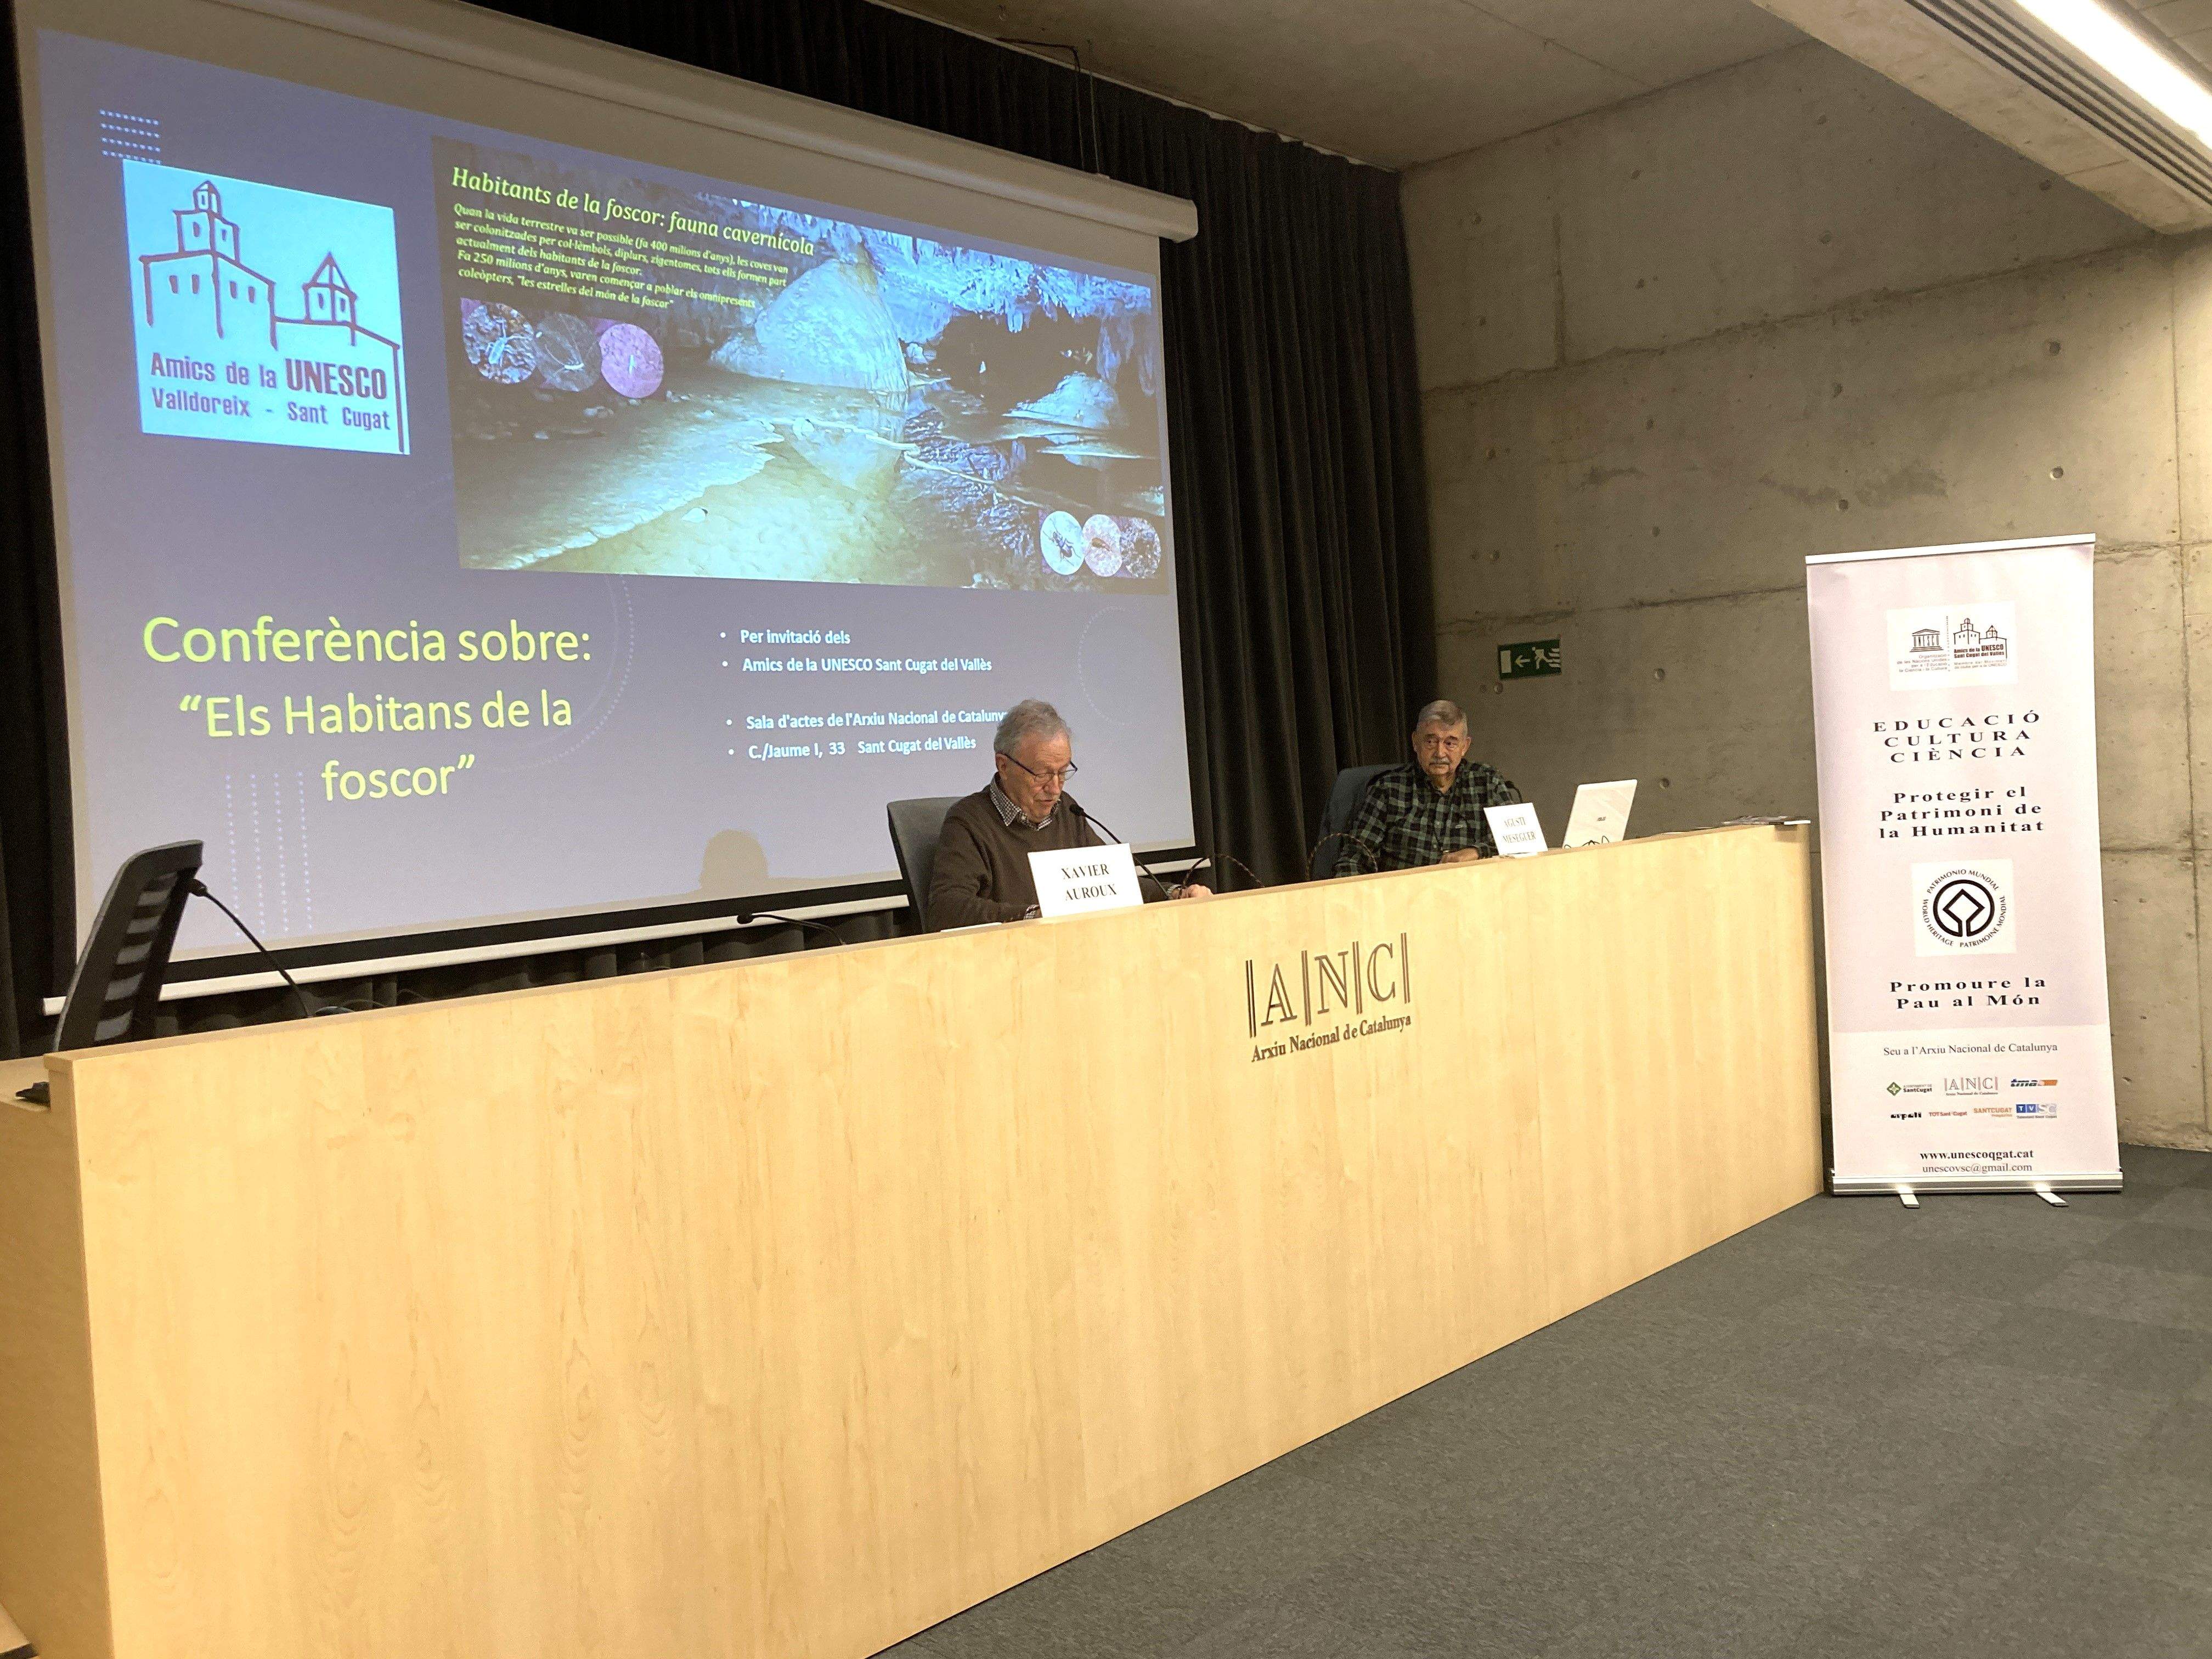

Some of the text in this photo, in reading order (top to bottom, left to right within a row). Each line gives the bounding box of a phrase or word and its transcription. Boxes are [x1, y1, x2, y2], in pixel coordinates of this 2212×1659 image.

[452, 167, 814, 256] Habitants de la foscor: fauna cavernícola
[454, 203, 482, 218] Quan
[485, 209, 494, 219] la
[497, 213, 518, 224] vida
[522, 217, 565, 233] terrestre
[567, 227, 578, 235] va
[580, 229, 594, 238] ser
[597, 232, 633, 245] possible
[635, 236, 648, 250] (fa
[650, 240, 668, 252] 400
[670, 245, 701, 258] milions
[737, 256, 748, 266] les
[750, 261, 772, 272] coves
[774, 264, 788, 274] van
[455, 221, 472, 230] ser
[473, 224, 537, 242] colonitzades
[539, 236, 556, 246] per
[614, 247, 649, 264] diplurs,
[651, 254, 702, 273] zigentomes,
[704, 263, 720, 275] tots
[722, 266, 736, 278] ells
[737, 270, 767, 284] formen
[769, 277, 787, 287] part
[456, 237, 515, 255] actualment
[518, 246, 537, 258] dels
[540, 249, 585, 267] habitants
[588, 258, 599, 268] de
[601, 259, 610, 270] la
[458, 250, 471, 261] Fa
[473, 252, 494, 265] 250
[496, 257, 532, 272] milions
[534, 263, 567, 278] d'anys,
[571, 270, 597, 282] varen
[600, 276, 645, 290] començar
[654, 284, 684, 297] poblar
[686, 290, 698, 300] els
[699, 292, 756, 308] omnipresents
[537, 280, 577, 294] estrelles
[579, 286, 594, 297] del
[595, 290, 616, 300] món
[618, 292, 629, 302] de
[631, 294, 640, 303] la
[151, 352, 387, 399] Amics de la UNESCO
[152, 387, 250, 417] Valldoreix
[287, 400, 329, 425] Sant
[342, 407, 391, 432] Cugat
[142, 616, 591, 663] Conferència sobre:
[741, 629, 851, 645] Per invitació dels
[742, 658, 992, 674] Amics de la UNESCO Sant Cugat del Vallès
[285, 692, 472, 735] Habitans
[482, 690, 530, 729] de
[541, 689, 572, 727] la
[746, 715, 774, 730] Sala
[778, 714, 824, 729] d'actes
[827, 713, 844, 727] de
[845, 712, 885, 726] l'Arxiu
[888, 710, 938, 725] Nacional
[941, 710, 956, 723] de
[1872, 710, 2039, 732] EDUCACIÓ
[748, 743, 810, 761] C./Jaume
[828, 742, 845, 755] 33
[857, 740, 885, 754] Sant
[888, 738, 922, 755] Cugat
[924, 737, 943, 751] del
[944, 736, 977, 750] Vallès
[1884, 730, 2030, 747] CULTURA
[1891, 746, 2025, 763] CIÈNCIA
[1894, 786, 2026, 803] Protegir el
[1881, 804, 2041, 821] Patrimoni de
[1502, 832, 1536, 843] MESEGUER
[1879, 821, 2044, 838] la Humanitat
[1062, 864, 1109, 879] XAVIER
[1927, 869, 2000, 894] PATRIMONIO MUNDIAL
[1065, 884, 1117, 901] AUROUX
[1960, 895, 2007, 947] PATRIMOINE MONDIAL
[1927, 923, 1954, 947] HERITAGE
[1890, 977, 2046, 992] Promoure la
[1896, 994, 2040, 1009] Pau al Món
[1251, 1015, 1412, 1063] Arxiu Nacional de Catalunya
[1883, 1047, 1901, 1056] Seu
[1911, 1046, 1946, 1054] l'Arxiu
[1949, 1045, 1991, 1053] Nacional
[1994, 1044, 2006, 1052] de
[2008, 1043, 2058, 1053] Catalunya
[1920, 1149, 2034, 1160] www.unescoqgat.cat
[1923, 1163, 2033, 1174] unescovsc@gmail.com
